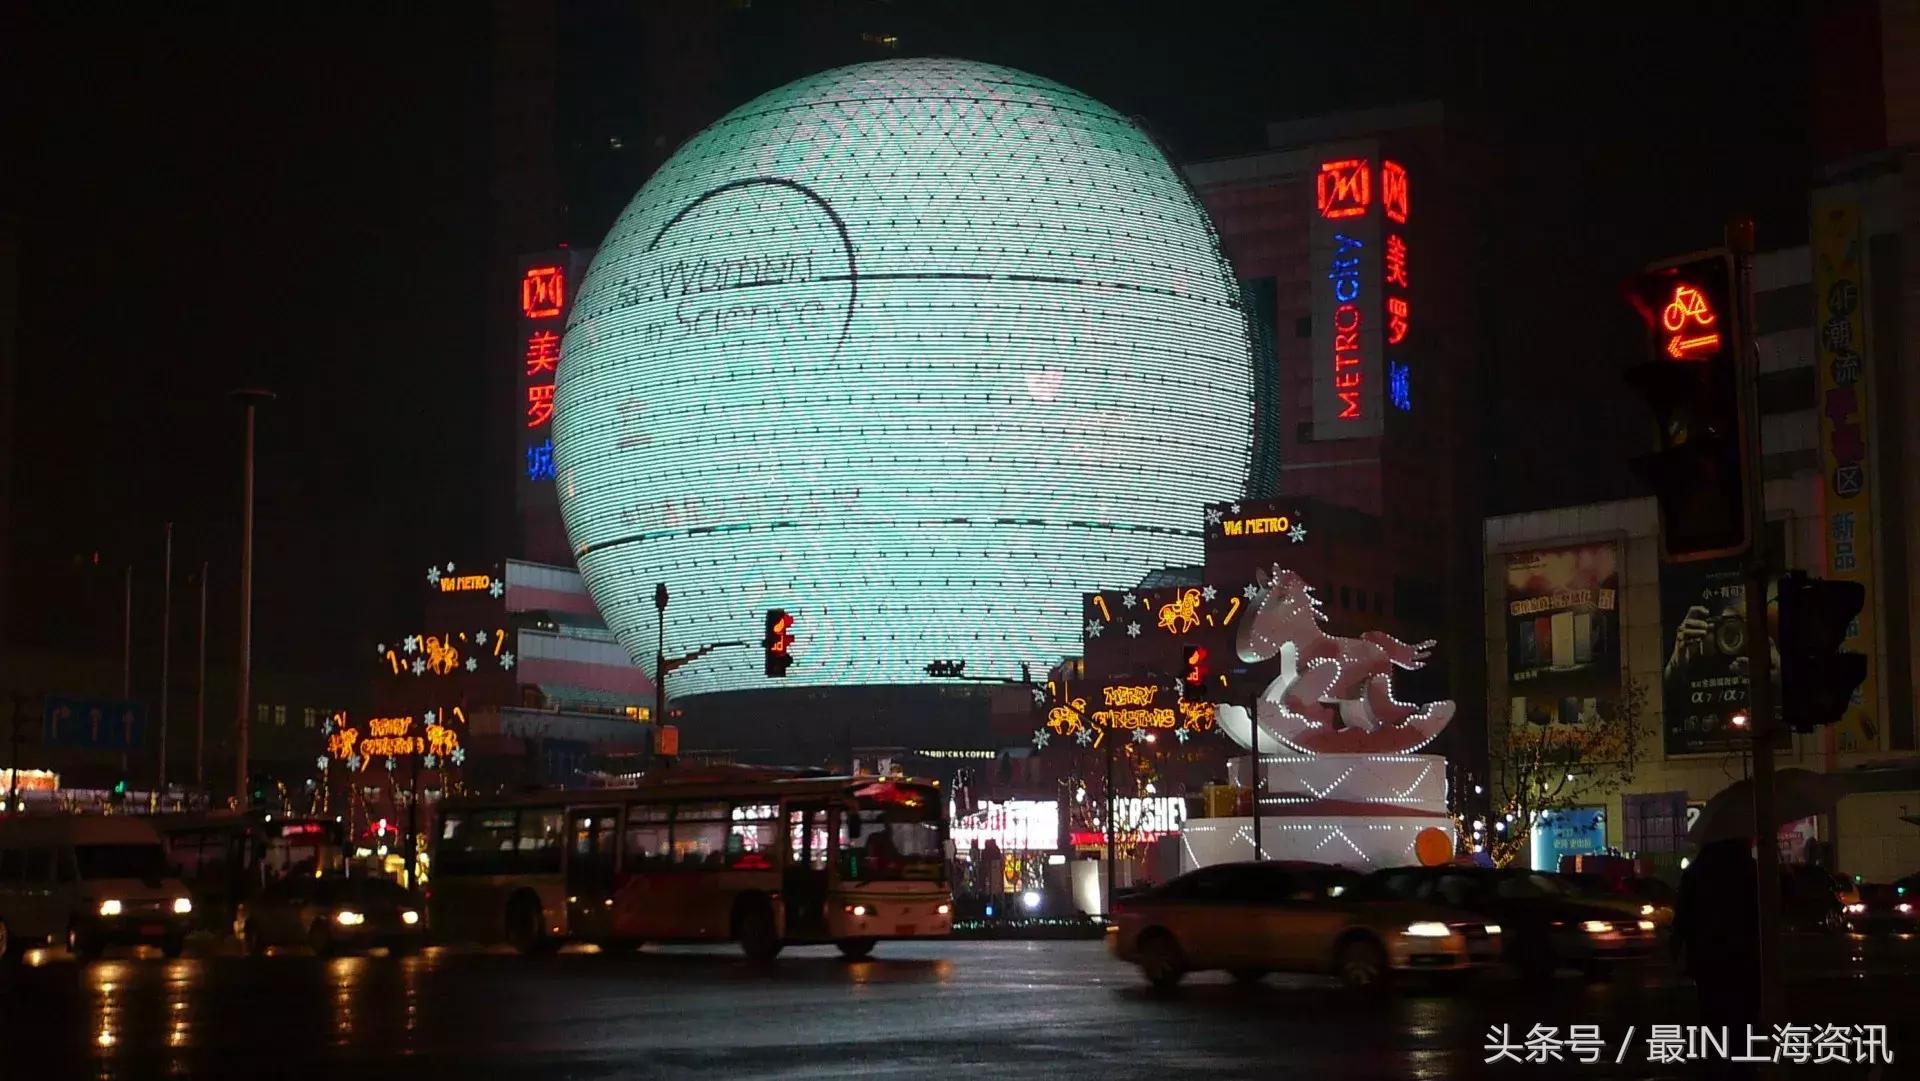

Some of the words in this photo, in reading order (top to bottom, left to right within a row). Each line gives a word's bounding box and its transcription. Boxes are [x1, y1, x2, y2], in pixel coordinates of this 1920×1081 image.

[660, 256, 813, 300] Women
[1223, 520, 1243, 536] VIA
[1244, 516, 1289, 535] METRO
[440, 577, 456, 592] VIA
[456, 574, 491, 592] METRO
[1104, 686, 1158, 706] MERRY
[1091, 709, 1176, 730] CHRISTMAS
[965, 751, 996, 760] COFFEE
